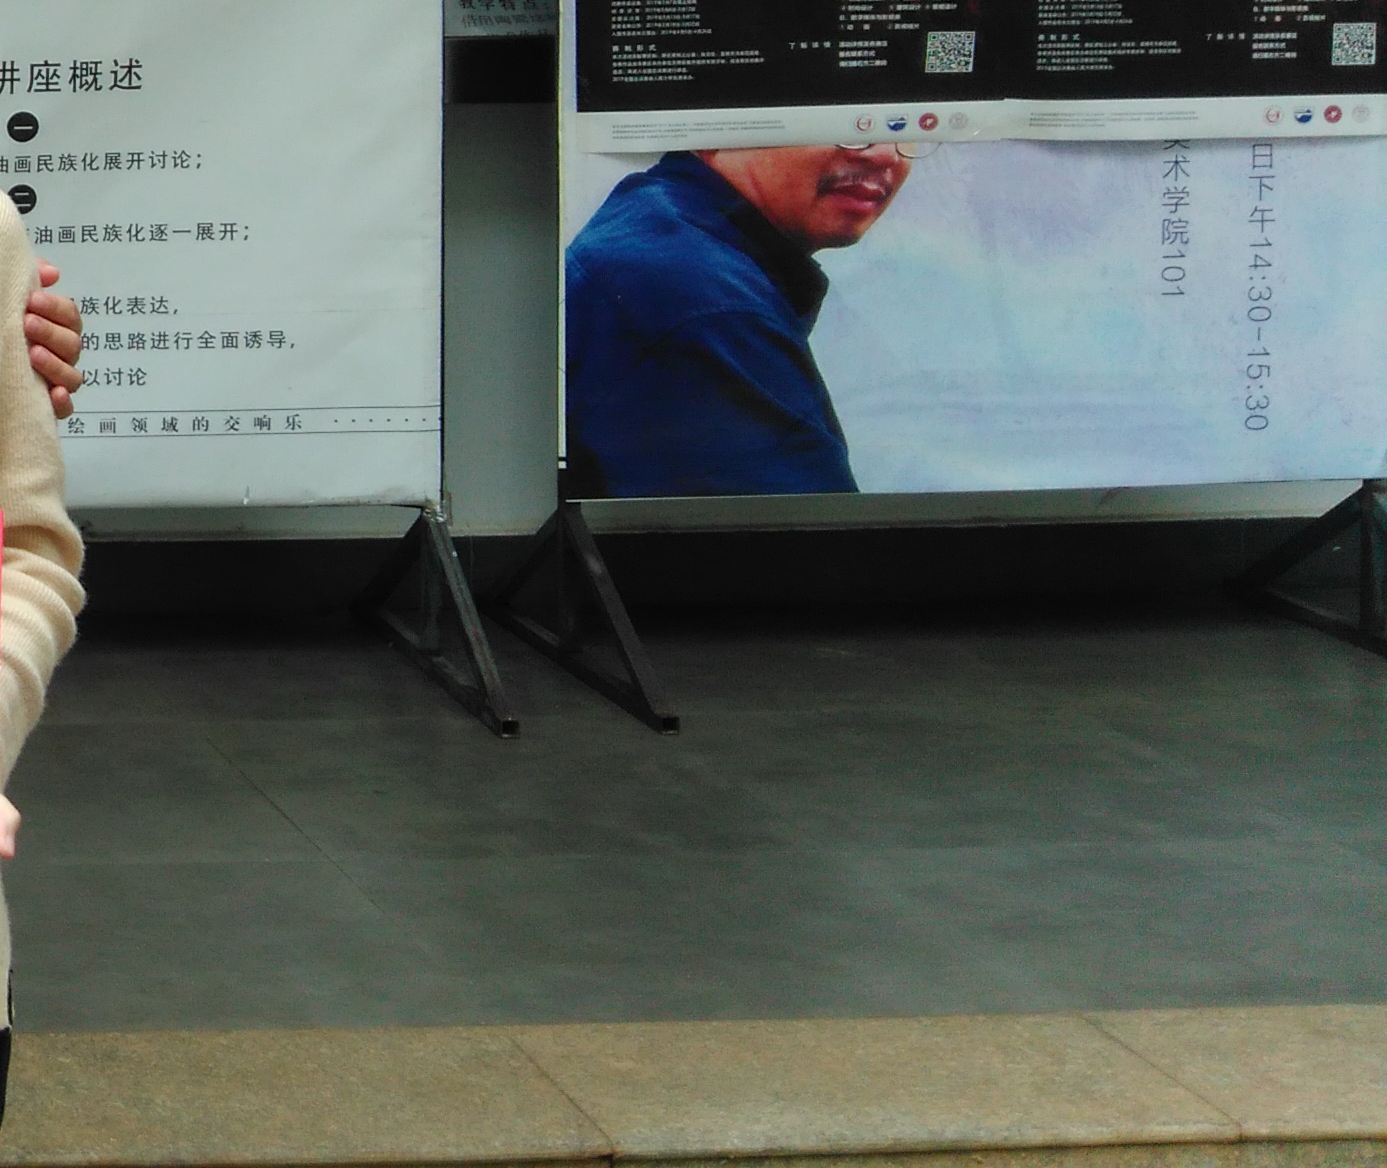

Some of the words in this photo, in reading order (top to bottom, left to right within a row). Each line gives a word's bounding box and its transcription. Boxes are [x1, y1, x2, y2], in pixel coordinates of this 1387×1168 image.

[1243, 142, 1276, 432] 日下午14:30-15:30
[67, 413, 304, 435] 绘画领域的交响乐
